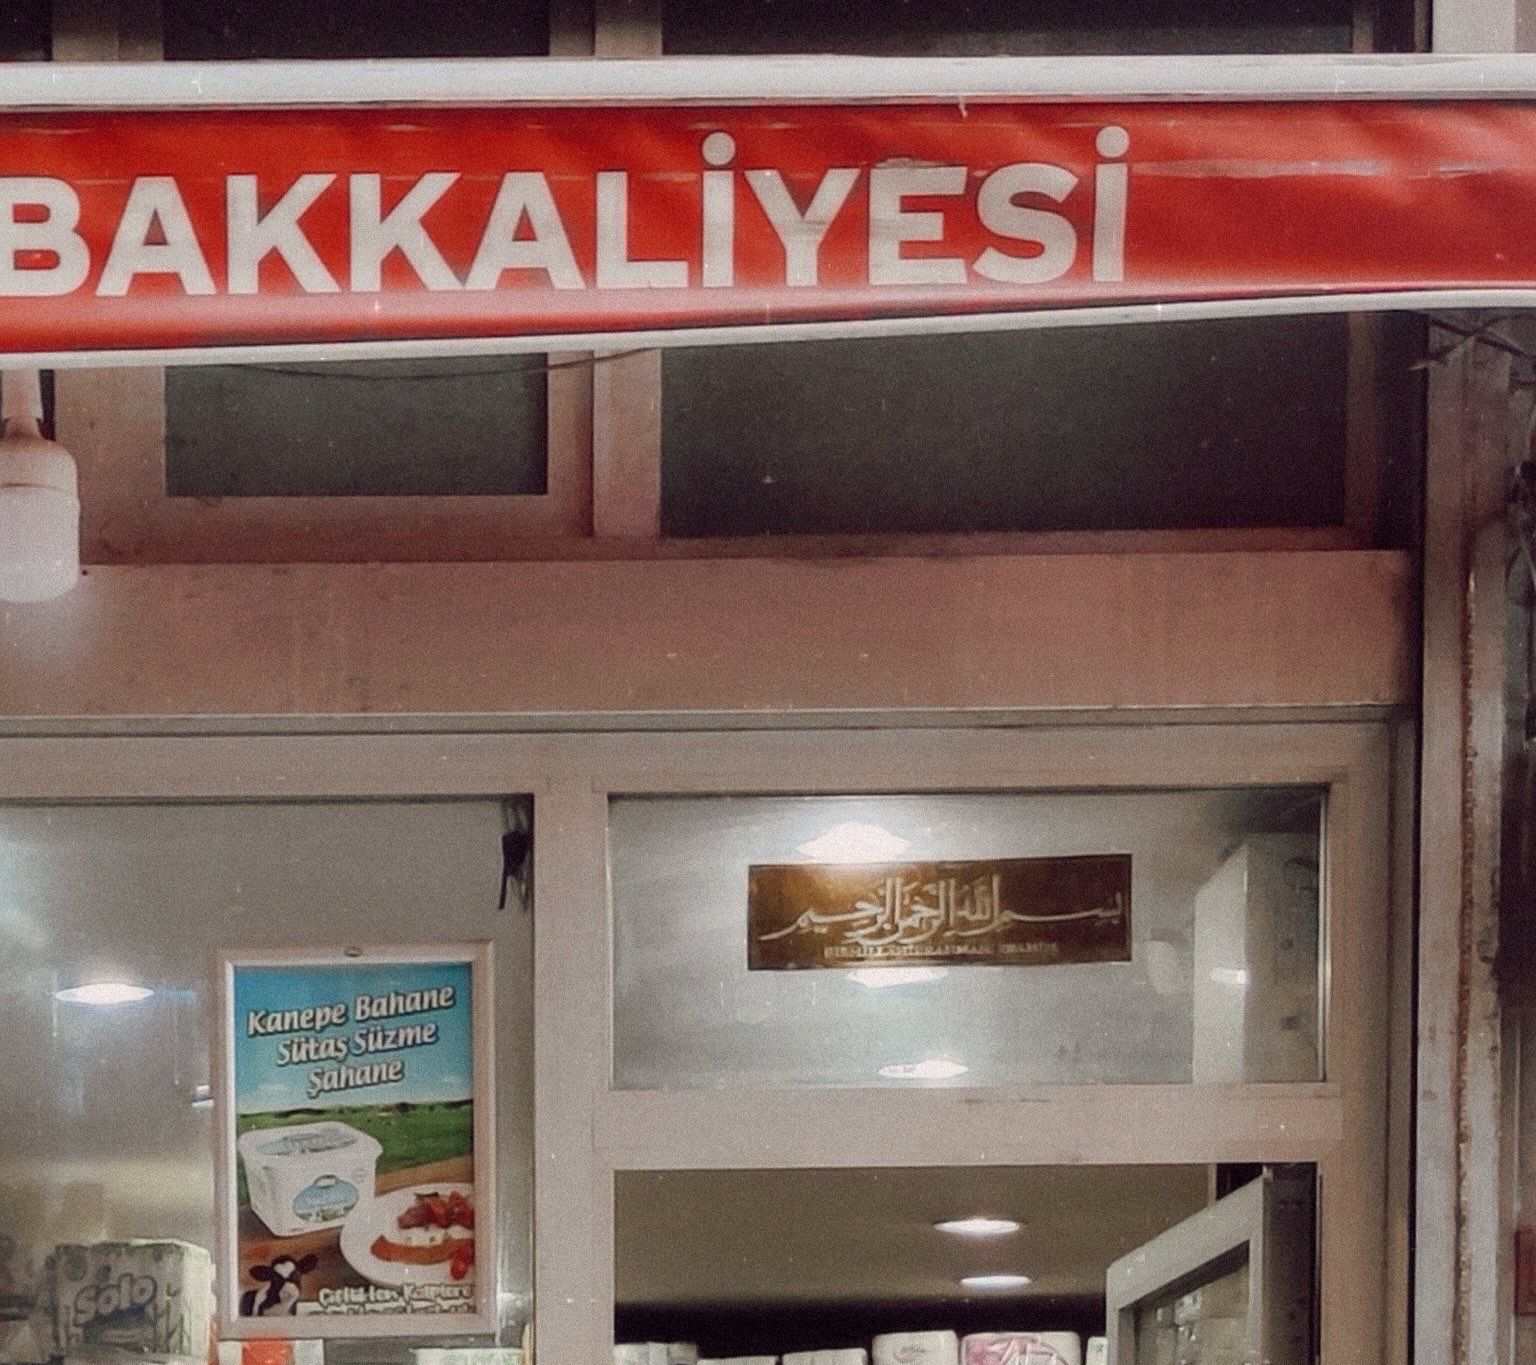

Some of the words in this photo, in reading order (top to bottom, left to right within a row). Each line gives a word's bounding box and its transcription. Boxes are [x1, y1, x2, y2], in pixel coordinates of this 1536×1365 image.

[248, 1002, 348, 1034] Kanepe
[354, 986, 455, 1022] Bahane
[276, 1033, 349, 1067] Sütaş
[349, 1022, 438, 1056] Süzme
[306, 1060, 405, 1099] Şahane
